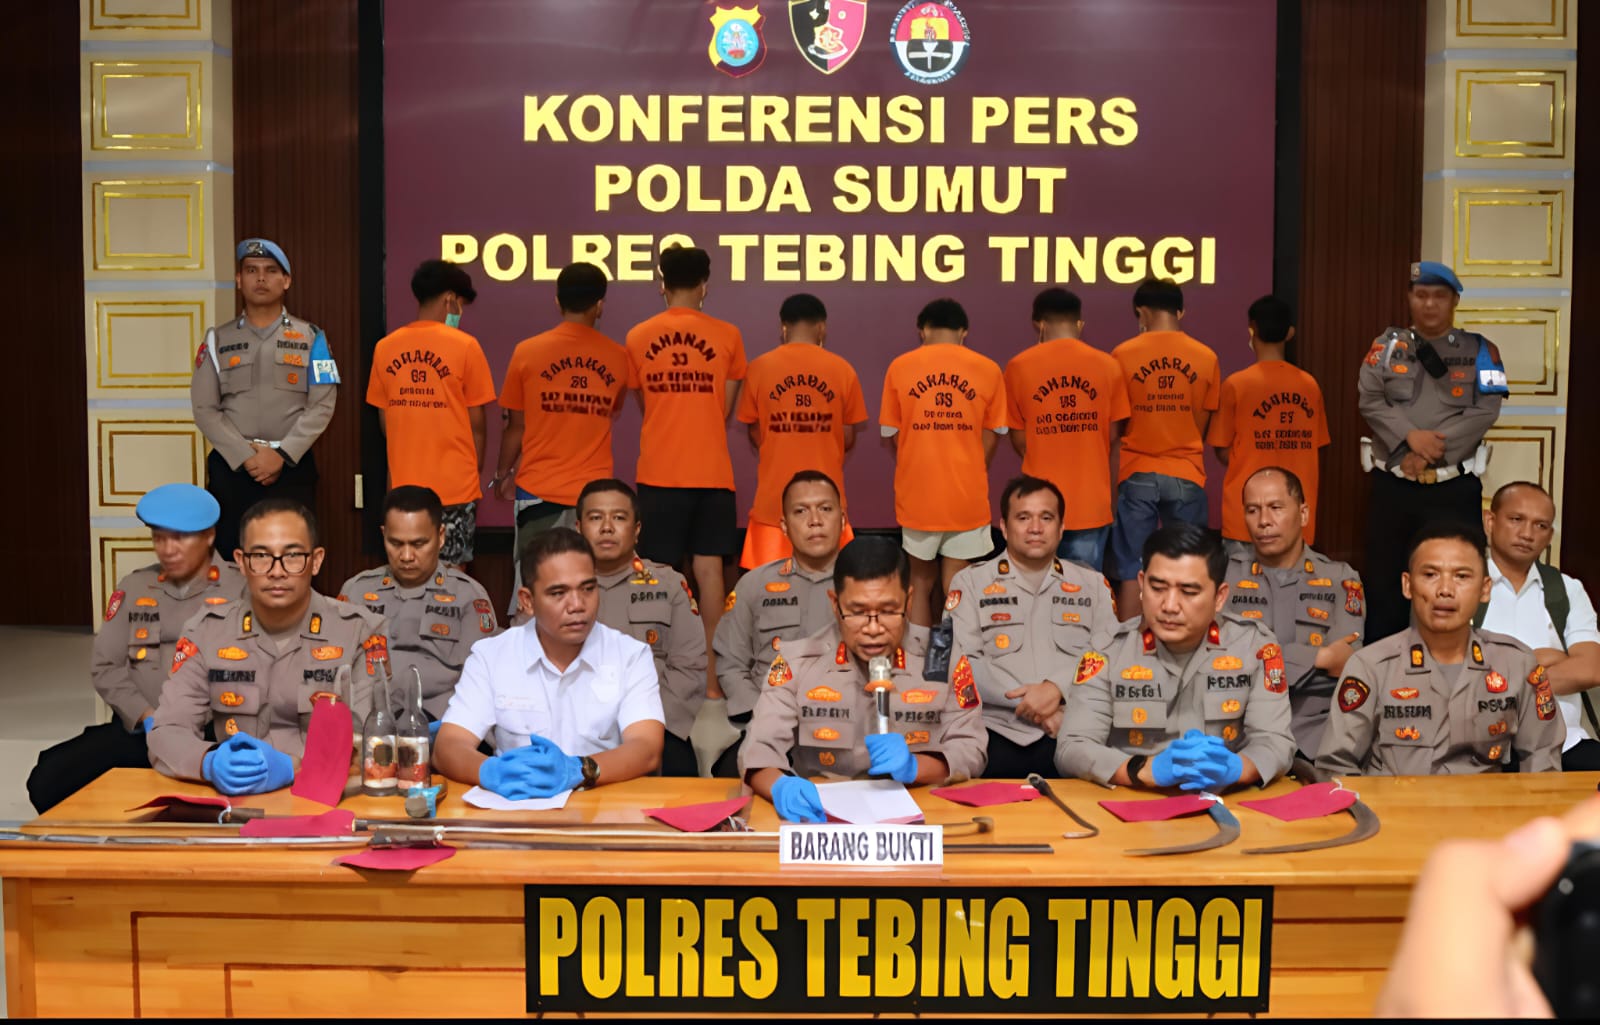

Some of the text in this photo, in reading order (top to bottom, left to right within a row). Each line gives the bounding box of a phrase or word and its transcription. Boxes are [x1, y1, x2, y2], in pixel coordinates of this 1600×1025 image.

[523, 95, 1138, 145] KONFERENSI PERS
[596, 164, 1067, 213] POLDA SUMUT
[719, 235, 965, 283] TEBING
[988, 236, 1216, 284] TINGGI
[791, 832, 933, 861] BARANG BUKTI
[539, 896, 1263, 1000] POLRES TEBING TINGGI
